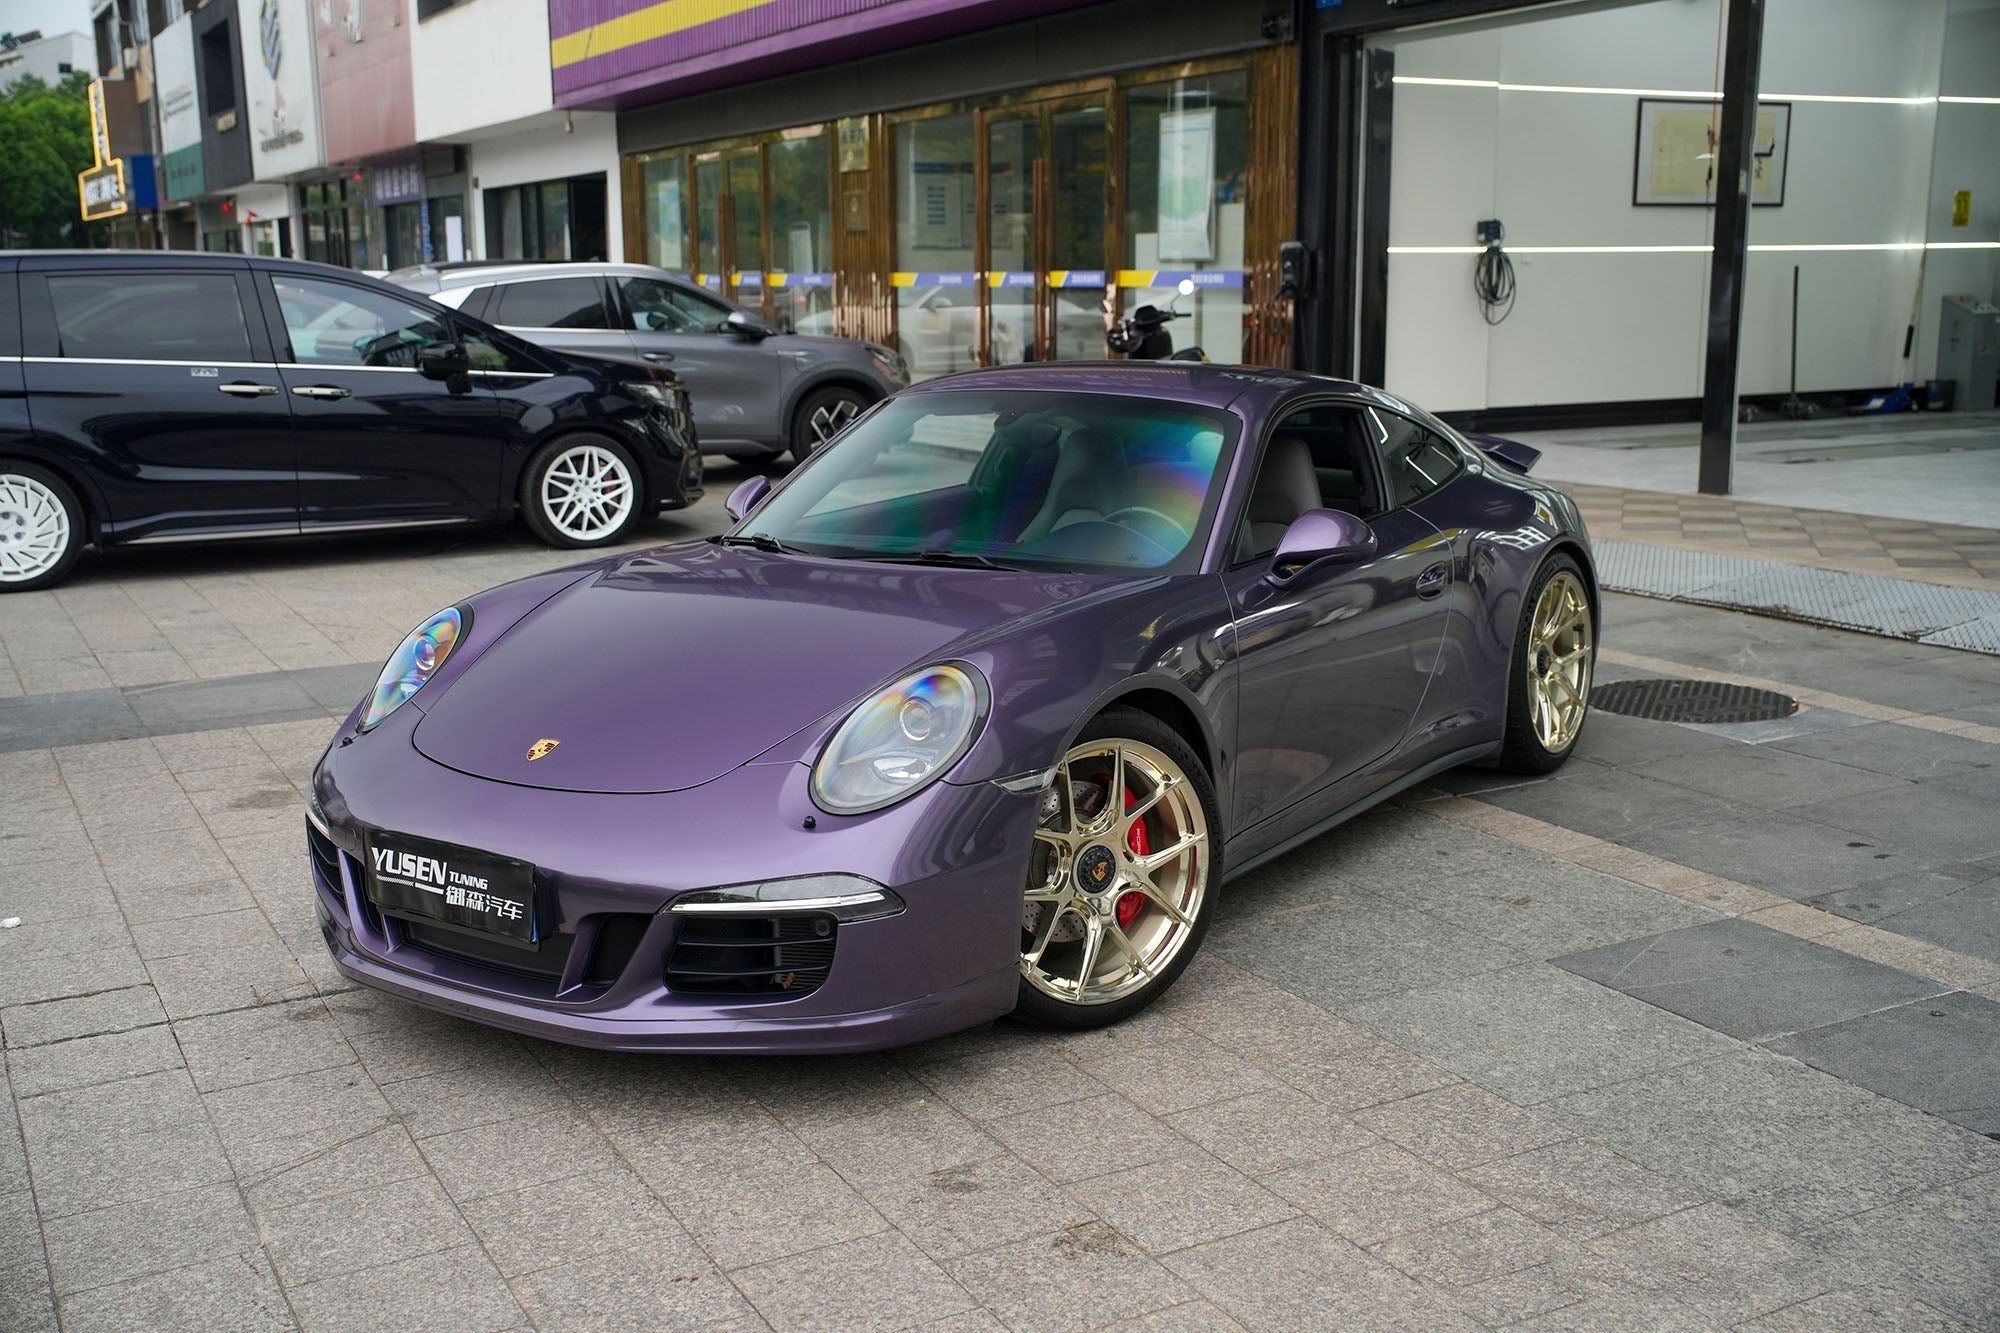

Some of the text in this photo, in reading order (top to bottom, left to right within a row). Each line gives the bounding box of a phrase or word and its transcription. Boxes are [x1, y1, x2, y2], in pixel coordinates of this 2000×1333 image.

[371, 847, 488, 890] YUSEN TUNING
[445, 885, 524, 920] 御森汽车
